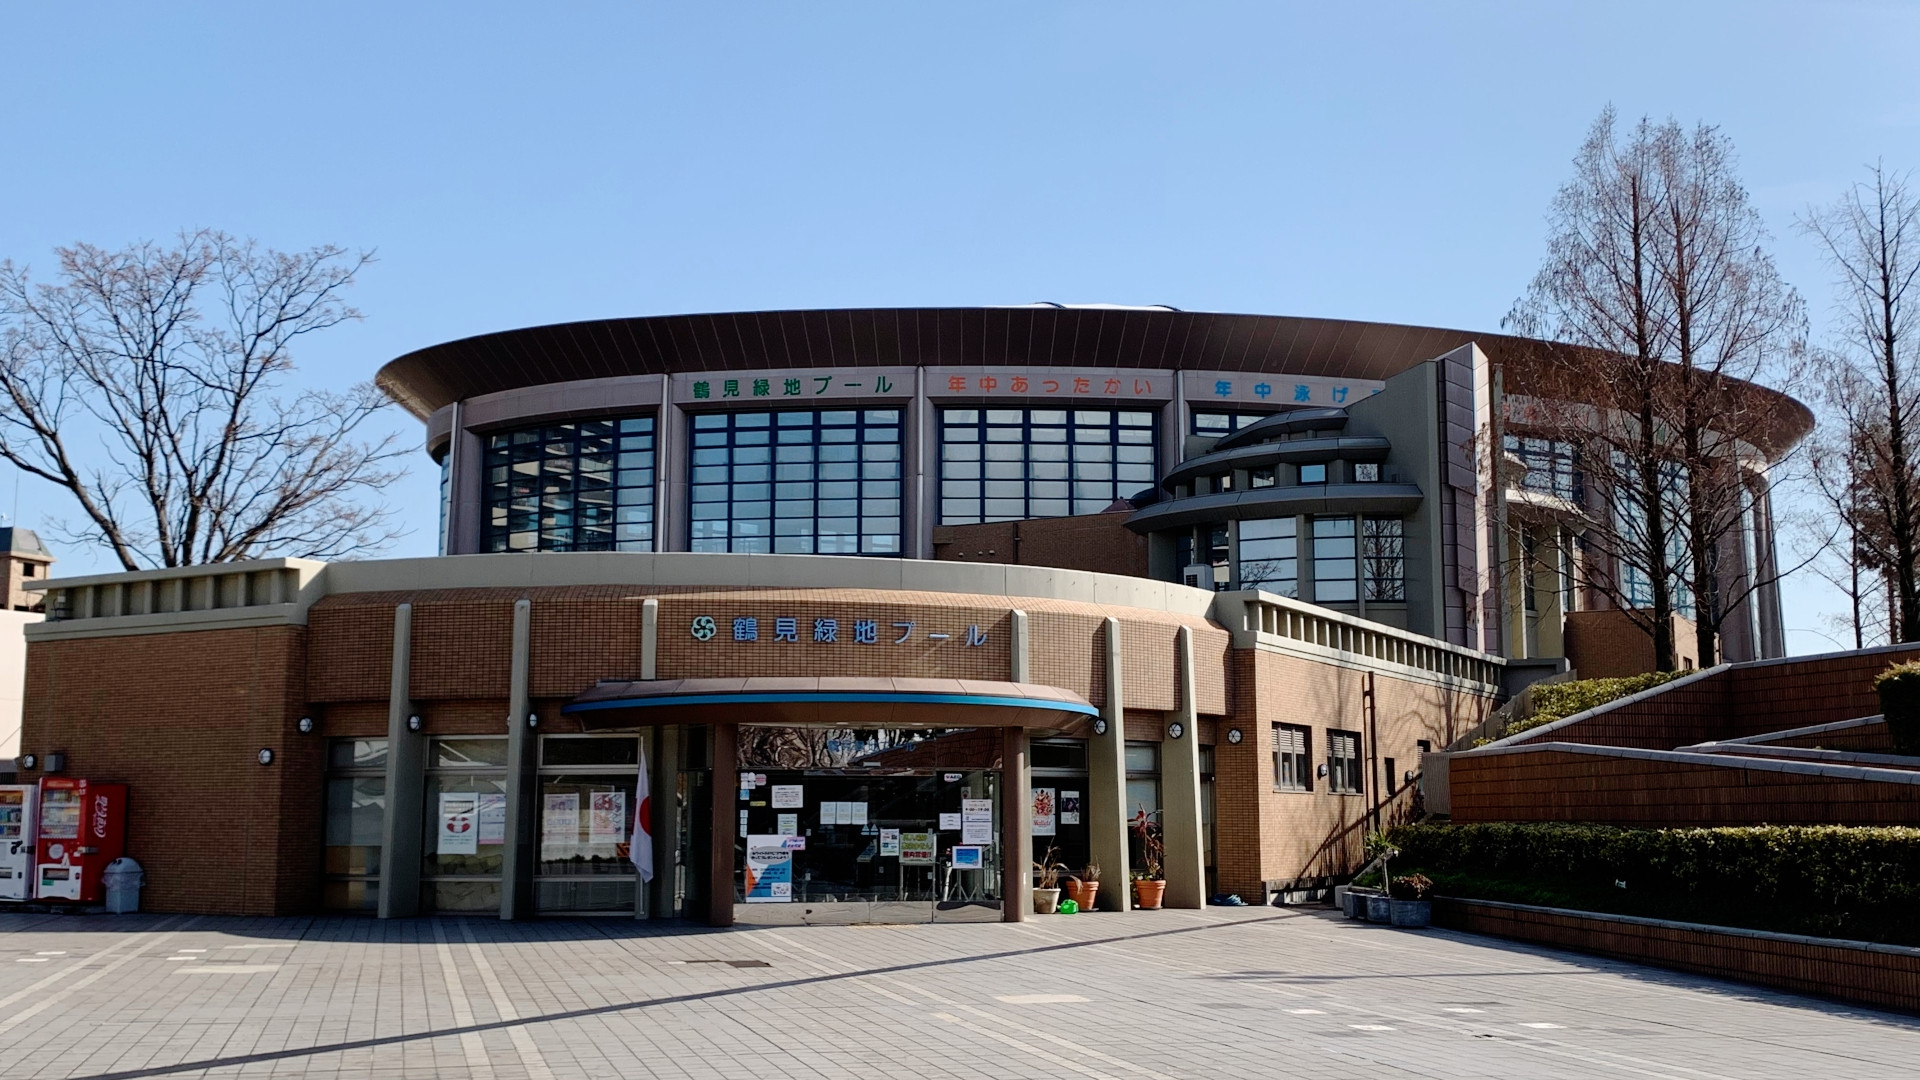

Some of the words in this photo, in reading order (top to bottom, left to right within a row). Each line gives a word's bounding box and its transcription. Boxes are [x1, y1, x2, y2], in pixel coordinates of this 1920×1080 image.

[693, 376, 893, 398] 鶴見緑地プール
[948, 377, 1152, 395] 年中あったかい
[1215, 381, 1380, 403] 年中泳げ
[732, 617, 988, 647] 鶴見緑地プール
[93, 794, 108, 838] Coca-Cola
